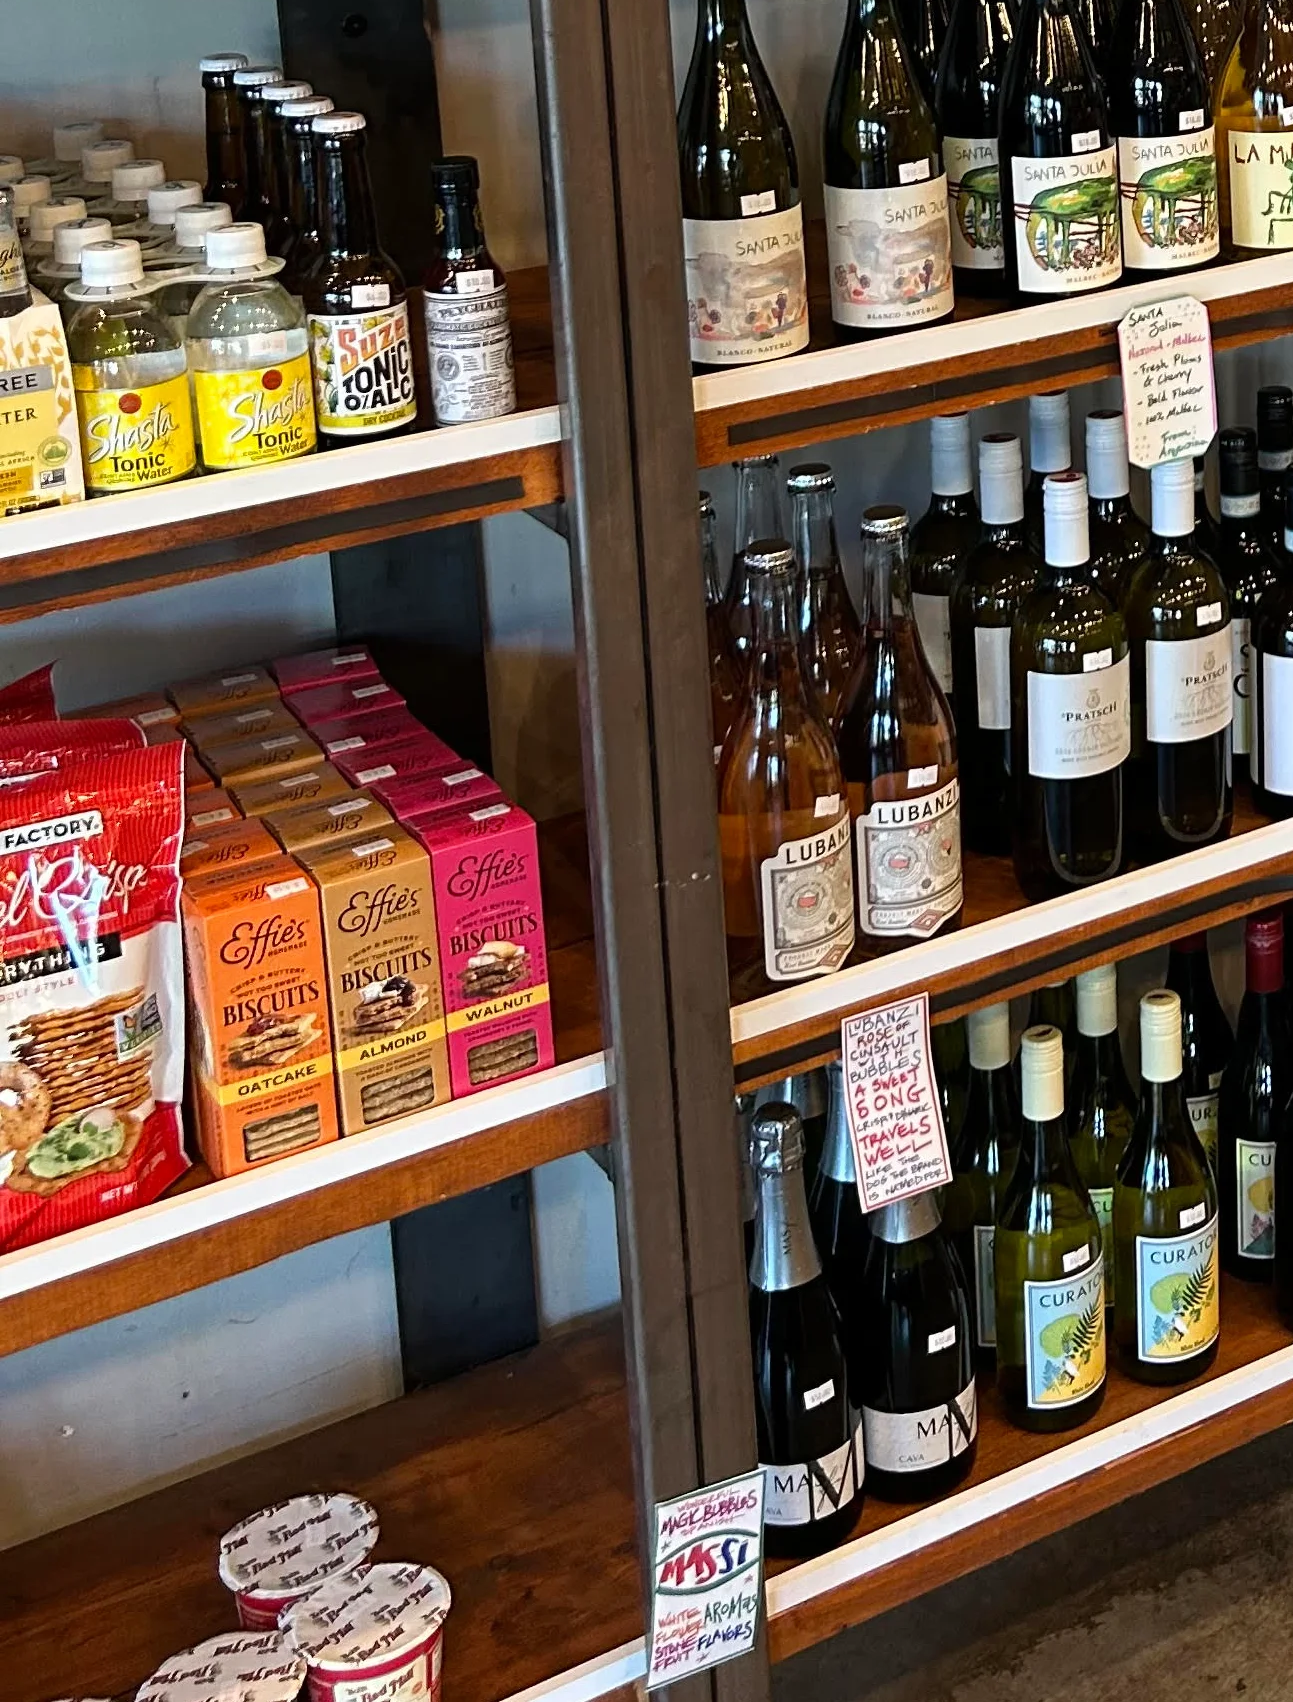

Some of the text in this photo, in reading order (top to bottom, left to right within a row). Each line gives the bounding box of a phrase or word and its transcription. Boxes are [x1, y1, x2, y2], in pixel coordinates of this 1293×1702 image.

[954, 145, 992, 162] SANTA
[1132, 143, 1173, 162] SANTA
[1234, 141, 1260, 164] LA
[1024, 159, 1107, 182] SANTA JULIA
[885, 205, 926, 224] SANTA
[736, 235, 779, 256] SANTA
[1128, 307, 1164, 327] SANTA
[86, 401, 178, 464] Shasta
[254, 426, 303, 449] Tonic
[279, 437, 309, 456] Water
[109, 452, 166, 473] Tonic
[136, 465, 173, 481] Water
[1185, 663, 1228, 687] PRATSCH
[1066, 701, 1117, 722] PRATSCH
[447, 849, 528, 902] Effie's
[338, 883, 419, 937] Effie's
[220, 915, 305, 970] Effie's
[450, 913, 538, 957] BISCUITS
[340, 947, 432, 994] BISCUITS
[223, 980, 320, 1027] BISCUITS
[466, 993, 533, 1022] WALNUT
[848, 1003, 919, 1038] LUBANZI
[359, 1031, 427, 1060] ALMOND
[857, 1026, 895, 1047] ROSE
[238, 1063, 318, 1096] OATCAKE
[855, 1066, 919, 1098] A SWEET
[856, 1083, 926, 1120] SONG
[859, 1115, 932, 1150] TRAVELS
[864, 1140, 933, 1168] WELL
[866, 1177, 888, 1191] DOG
